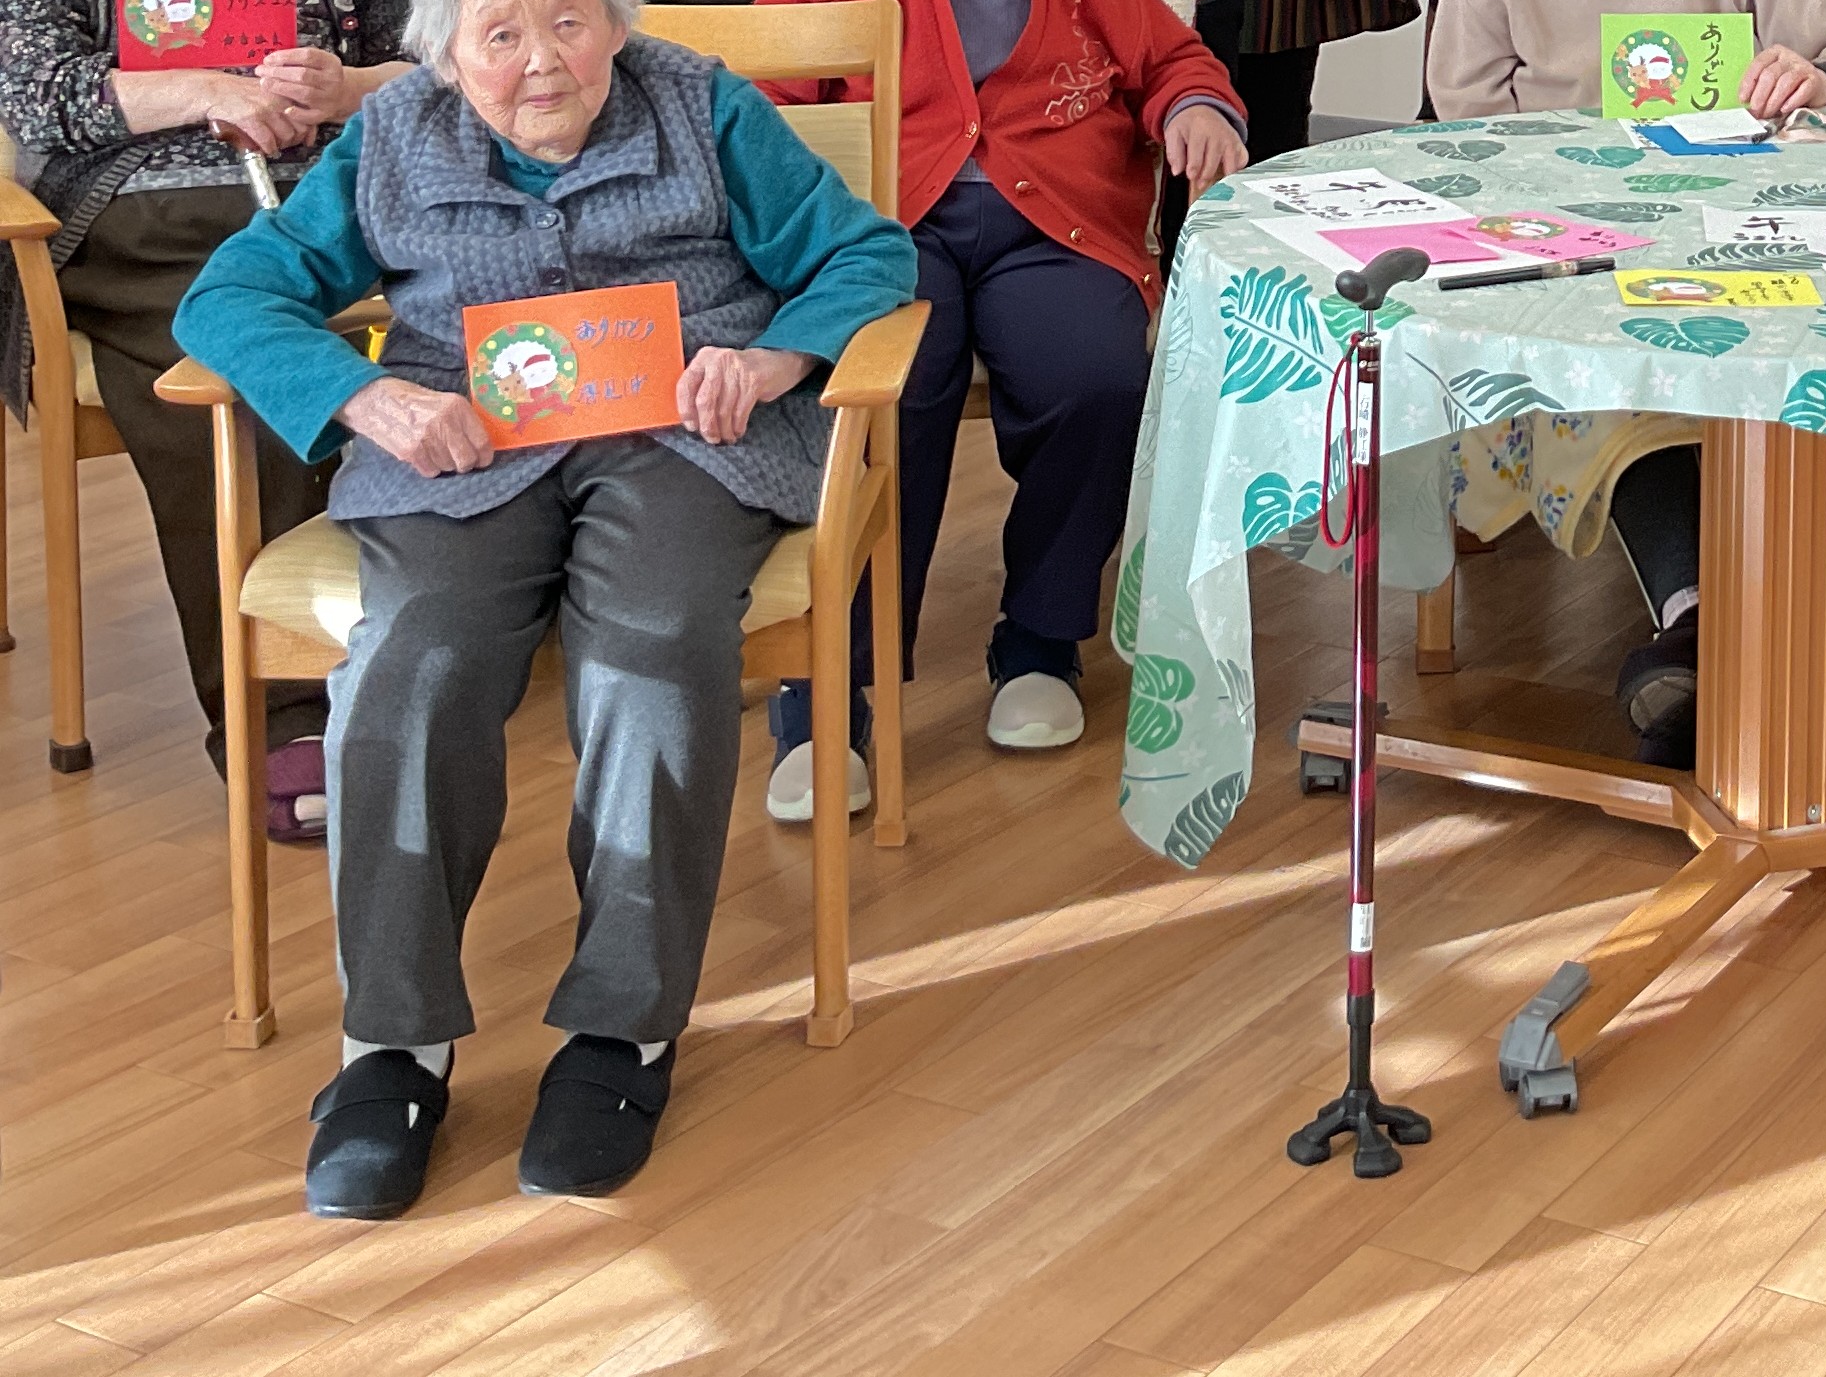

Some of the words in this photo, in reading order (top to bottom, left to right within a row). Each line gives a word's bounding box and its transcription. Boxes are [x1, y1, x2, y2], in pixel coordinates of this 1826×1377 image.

[1691, 21, 1724, 111] ありがとう
